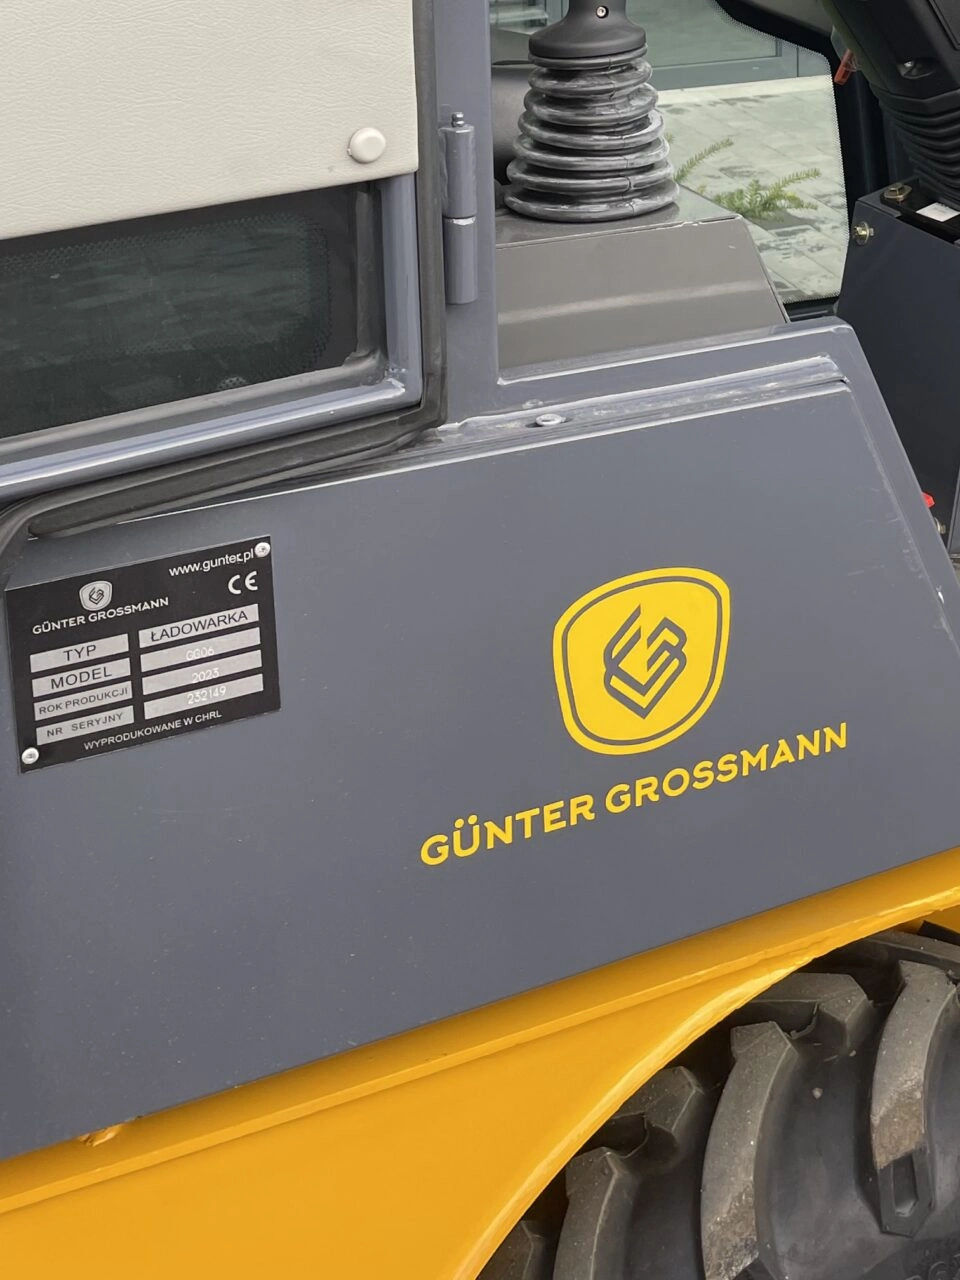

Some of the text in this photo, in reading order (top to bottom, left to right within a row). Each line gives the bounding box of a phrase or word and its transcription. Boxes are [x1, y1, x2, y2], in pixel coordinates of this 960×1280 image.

[227, 570, 258, 595] CE
[32, 596, 169, 635] GÜNTER GROSSMANN
[150, 610, 248, 642] ŁADOWARKA
[63, 644, 97, 662] TYP
[50, 666, 112, 690] MODEL
[38, 687, 128, 715] ROK PRODUKCJI
[46, 712, 123, 738] NR SERYJNY
[84, 709, 222, 751] WYPRODUKOWANE W CHRL
[420, 722, 848, 866] GÜNTER GROSSMANN
